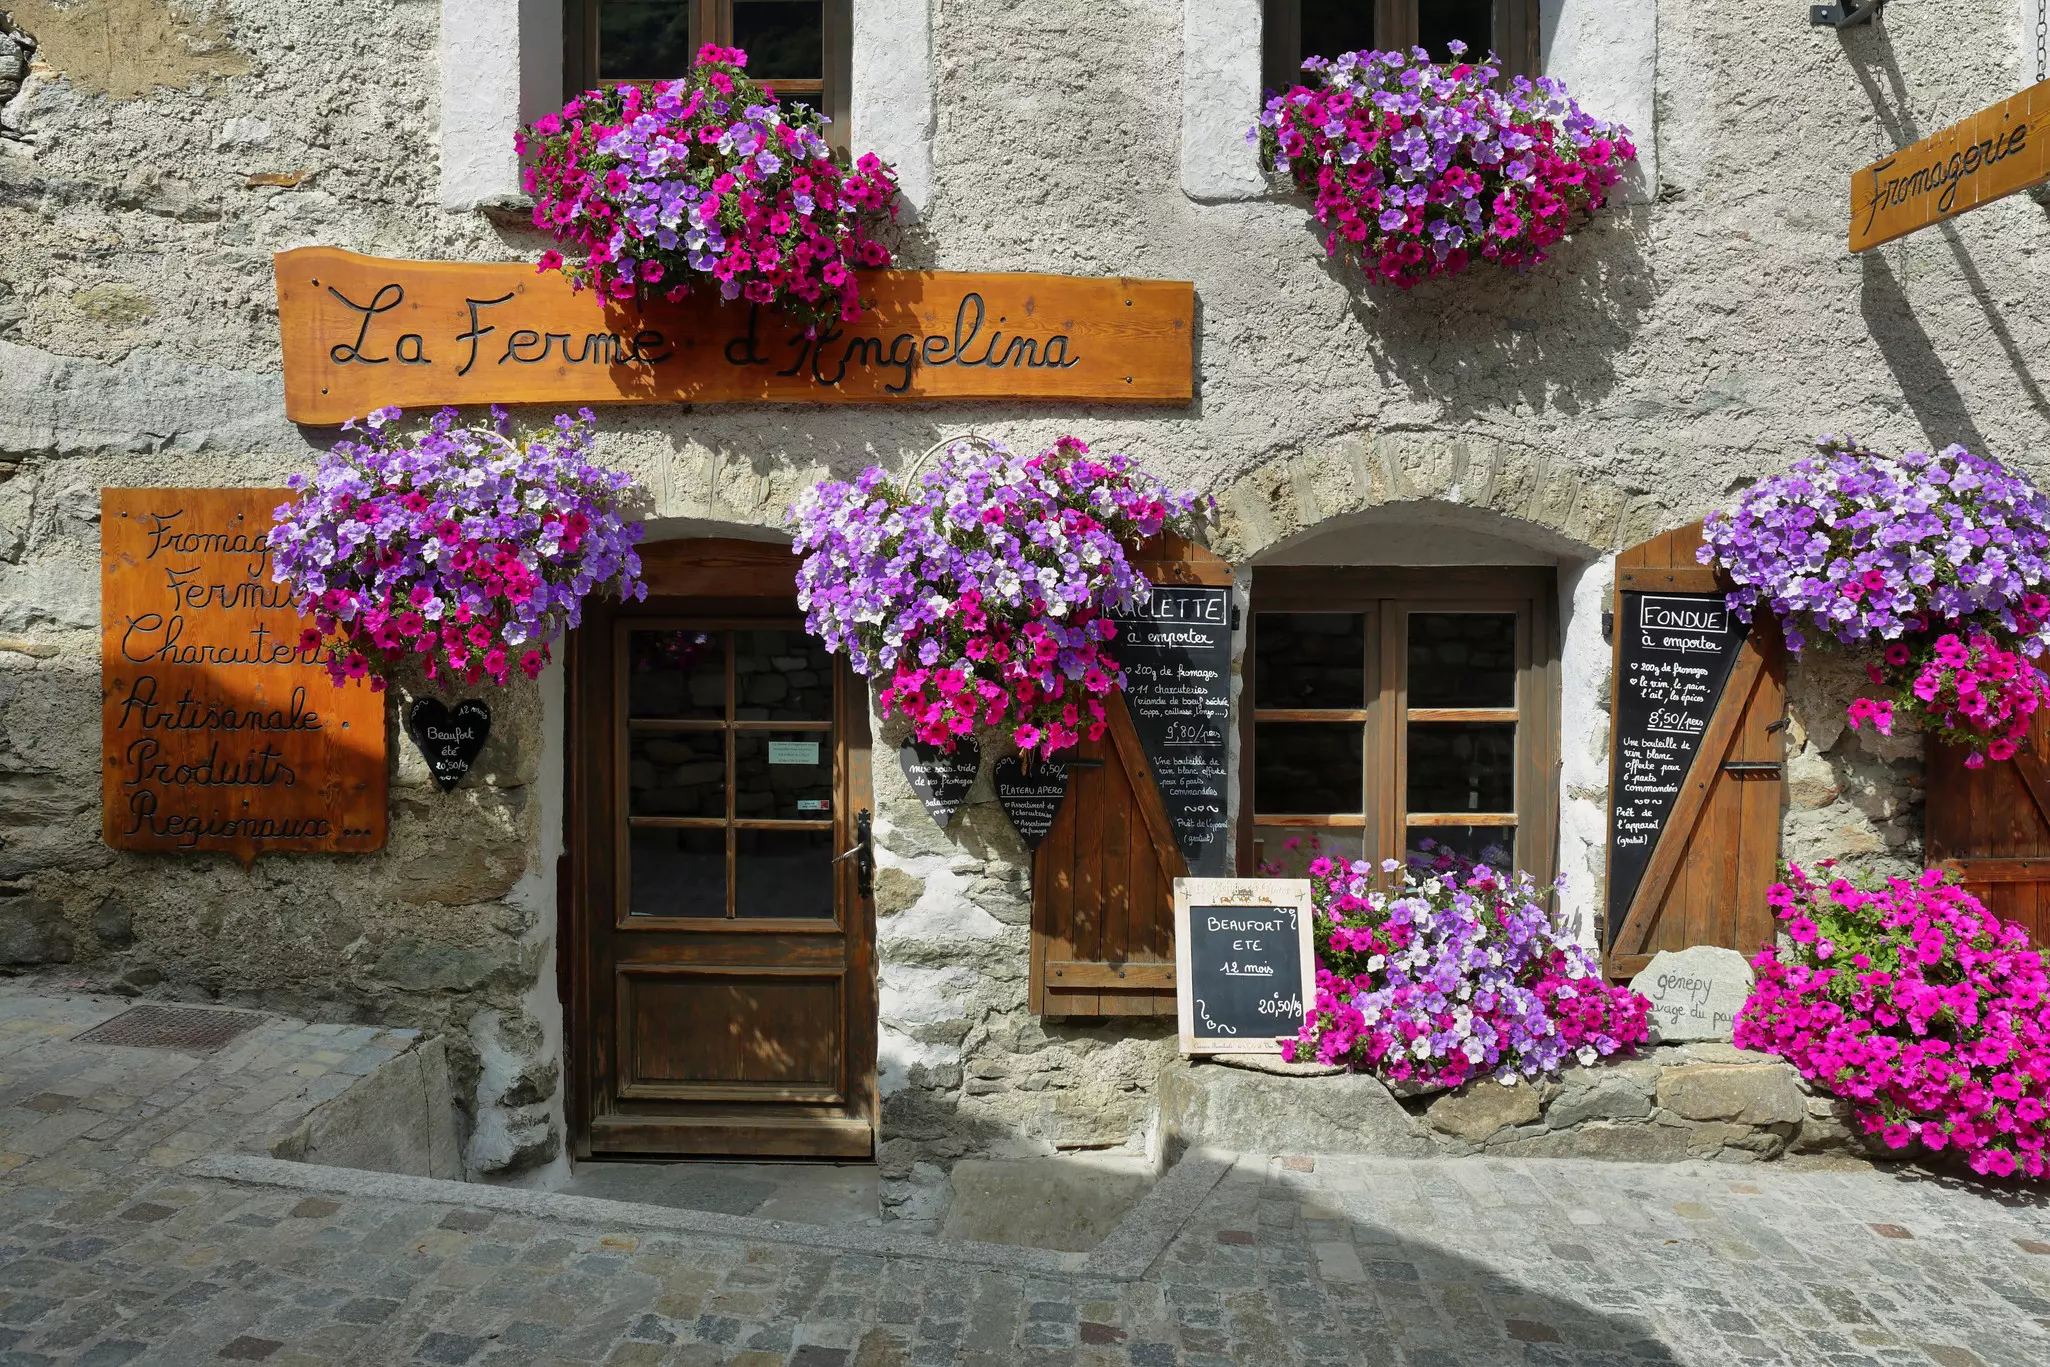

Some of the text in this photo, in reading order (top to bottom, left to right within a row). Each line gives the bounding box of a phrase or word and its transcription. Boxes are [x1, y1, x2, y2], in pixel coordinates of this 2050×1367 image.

[1863, 113, 2026, 236] Fromagerie
[328, 284, 1080, 394] La Ferme dAngelina
[147, 509, 274, 578] Fromag
[1644, 606, 1721, 629] FONDUE
[122, 613, 329, 665] Charcuteri
[1127, 625, 1214, 649] à emporter
[1642, 629, 1722, 653] à emporter
[1135, 664, 1218, 681] 200g de fromages
[1641, 662, 1708, 679] 200g de fromages
[1154, 684, 1208, 694] charcuteries
[1640, 675, 1648, 687] le
[1673, 677, 1682, 689] le
[1170, 696, 1179, 705] de
[1670, 690, 1679, 701] les
[118, 676, 324, 731] Artisanale
[427, 726, 475, 744] Beaufort
[1623, 736, 1691, 750] Une bouteille de
[441, 745, 459, 756] été
[1624, 748, 1674, 760] vin blanc
[124, 738, 297, 786] Produits
[1153, 755, 1220, 766] Une bouteille de
[1625, 758, 1681, 776] offerte pour
[1159, 766, 1175, 775] vin
[1178, 766, 1199, 775] blanc
[914, 776, 926, 786] de
[1160, 777, 1204, 788] pour 6 parts
[1623, 772, 1657, 785] 6 parts
[1000, 784, 1062, 795] PLATEAU APERO
[1011, 801, 1046, 809] Assortiment
[1616, 806, 1653, 817] Prêt de
[1177, 817, 1195, 827] Prêt
[1197, 819, 1206, 828] de
[1208, 917, 1284, 931] BEAUFORT
[1233, 940, 1263, 951] ETE
[1220, 961, 1274, 974] 12 mois
[1653, 970, 1712, 1005] génépy
[1690, 1003, 1707, 1019] du
[1712, 1011, 1734, 1031] pay
